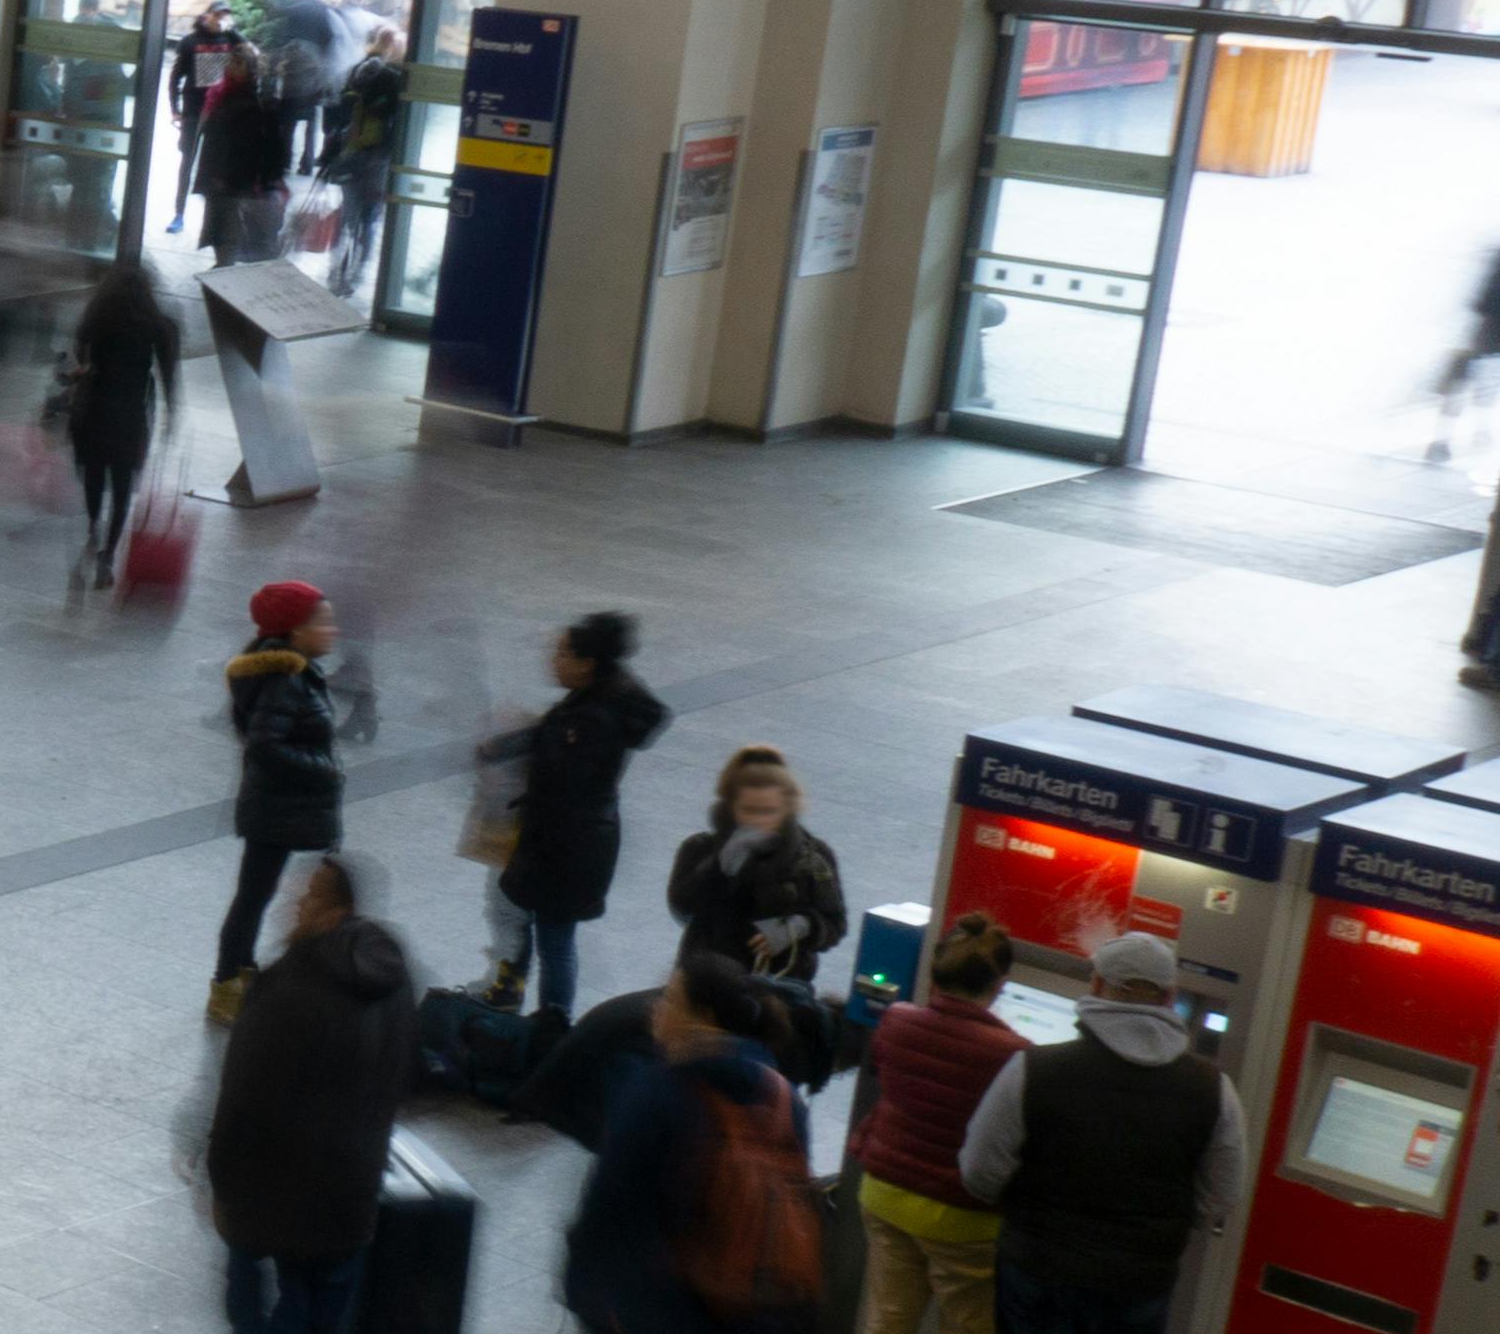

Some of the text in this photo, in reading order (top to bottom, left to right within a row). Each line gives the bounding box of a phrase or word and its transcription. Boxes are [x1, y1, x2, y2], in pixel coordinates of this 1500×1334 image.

[980, 756, 1118, 810] Fahrkarten
[1008, 837, 1055, 860] BAHN
[1338, 844, 1496, 903] Fahrkarten
[1366, 929, 1421, 955] BAHN
